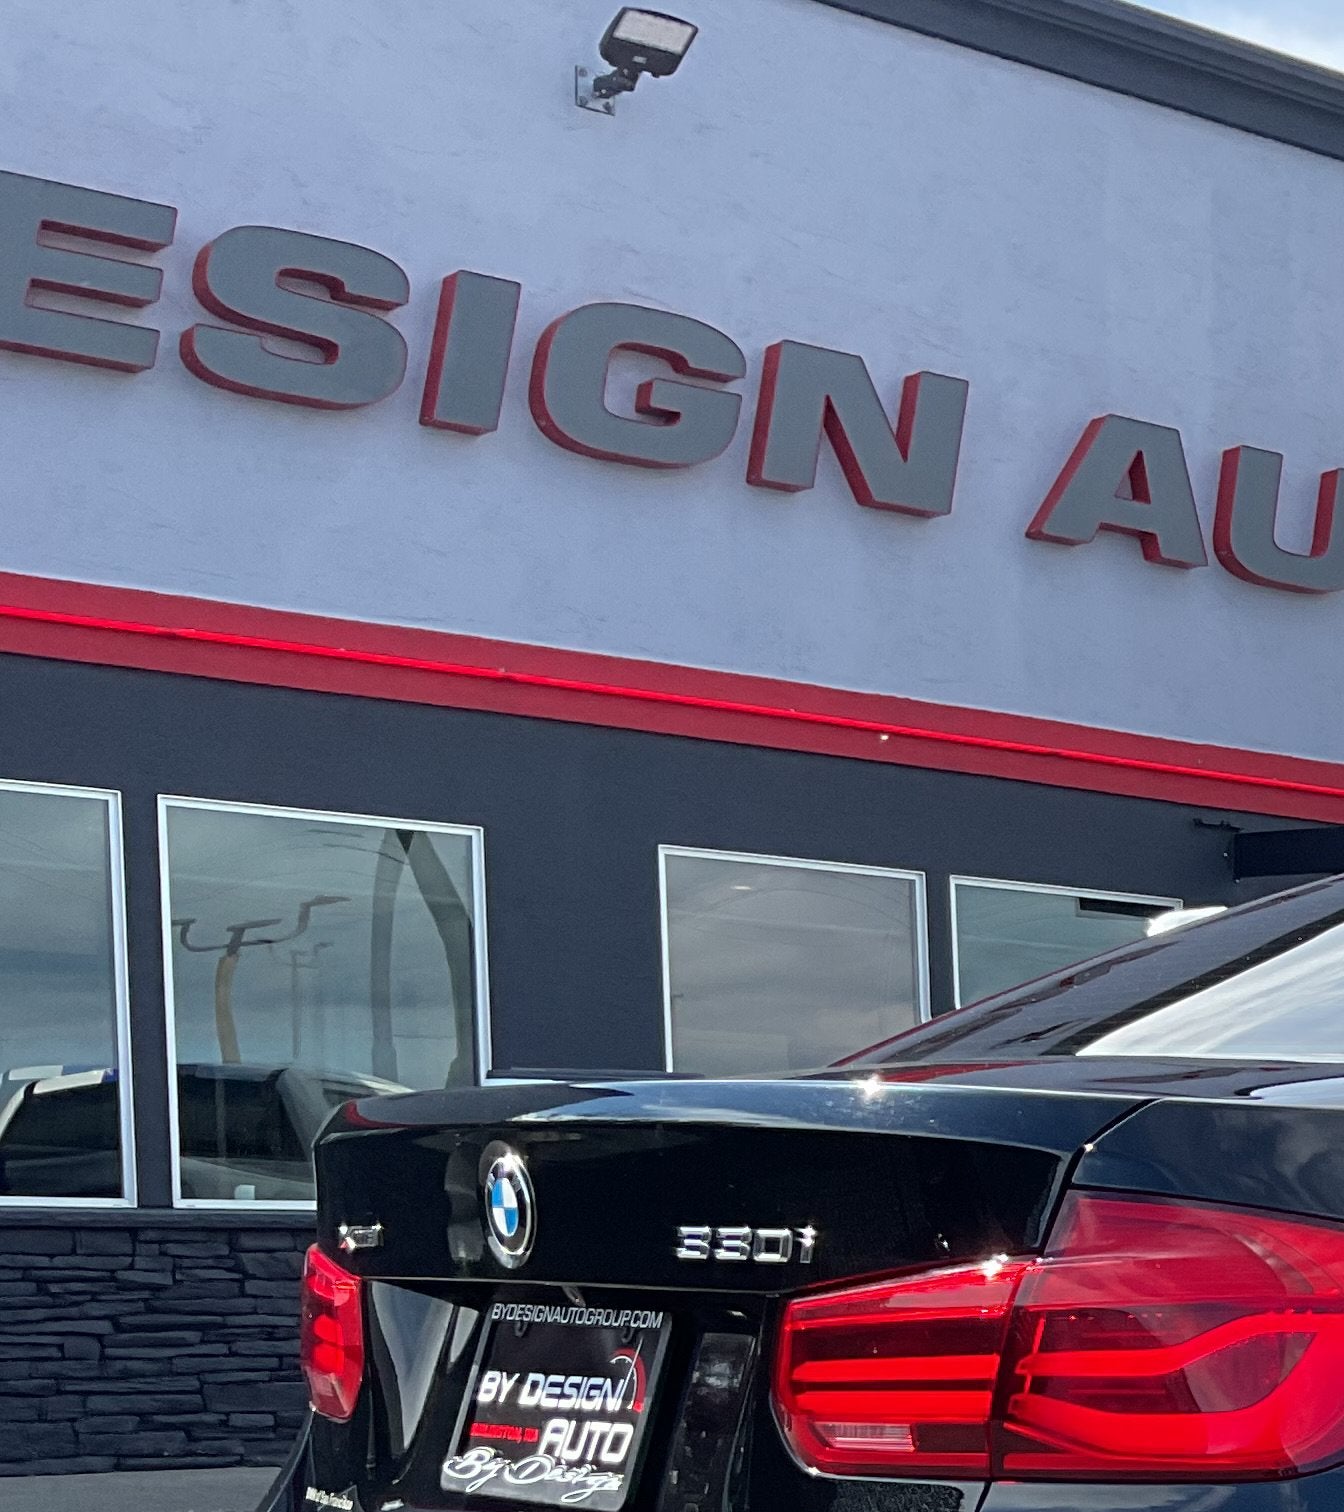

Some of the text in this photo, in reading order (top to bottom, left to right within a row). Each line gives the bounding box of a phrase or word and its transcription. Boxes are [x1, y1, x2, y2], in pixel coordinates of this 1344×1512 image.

[0, 170, 970, 517] ESIGN
[491, 1303, 663, 1329] BYDESIGNAUTOGROUP.COM
[476, 1371, 626, 1411] BY DESIGN
[537, 1418, 635, 1464] AUTO
[443, 1446, 512, 1493] By
